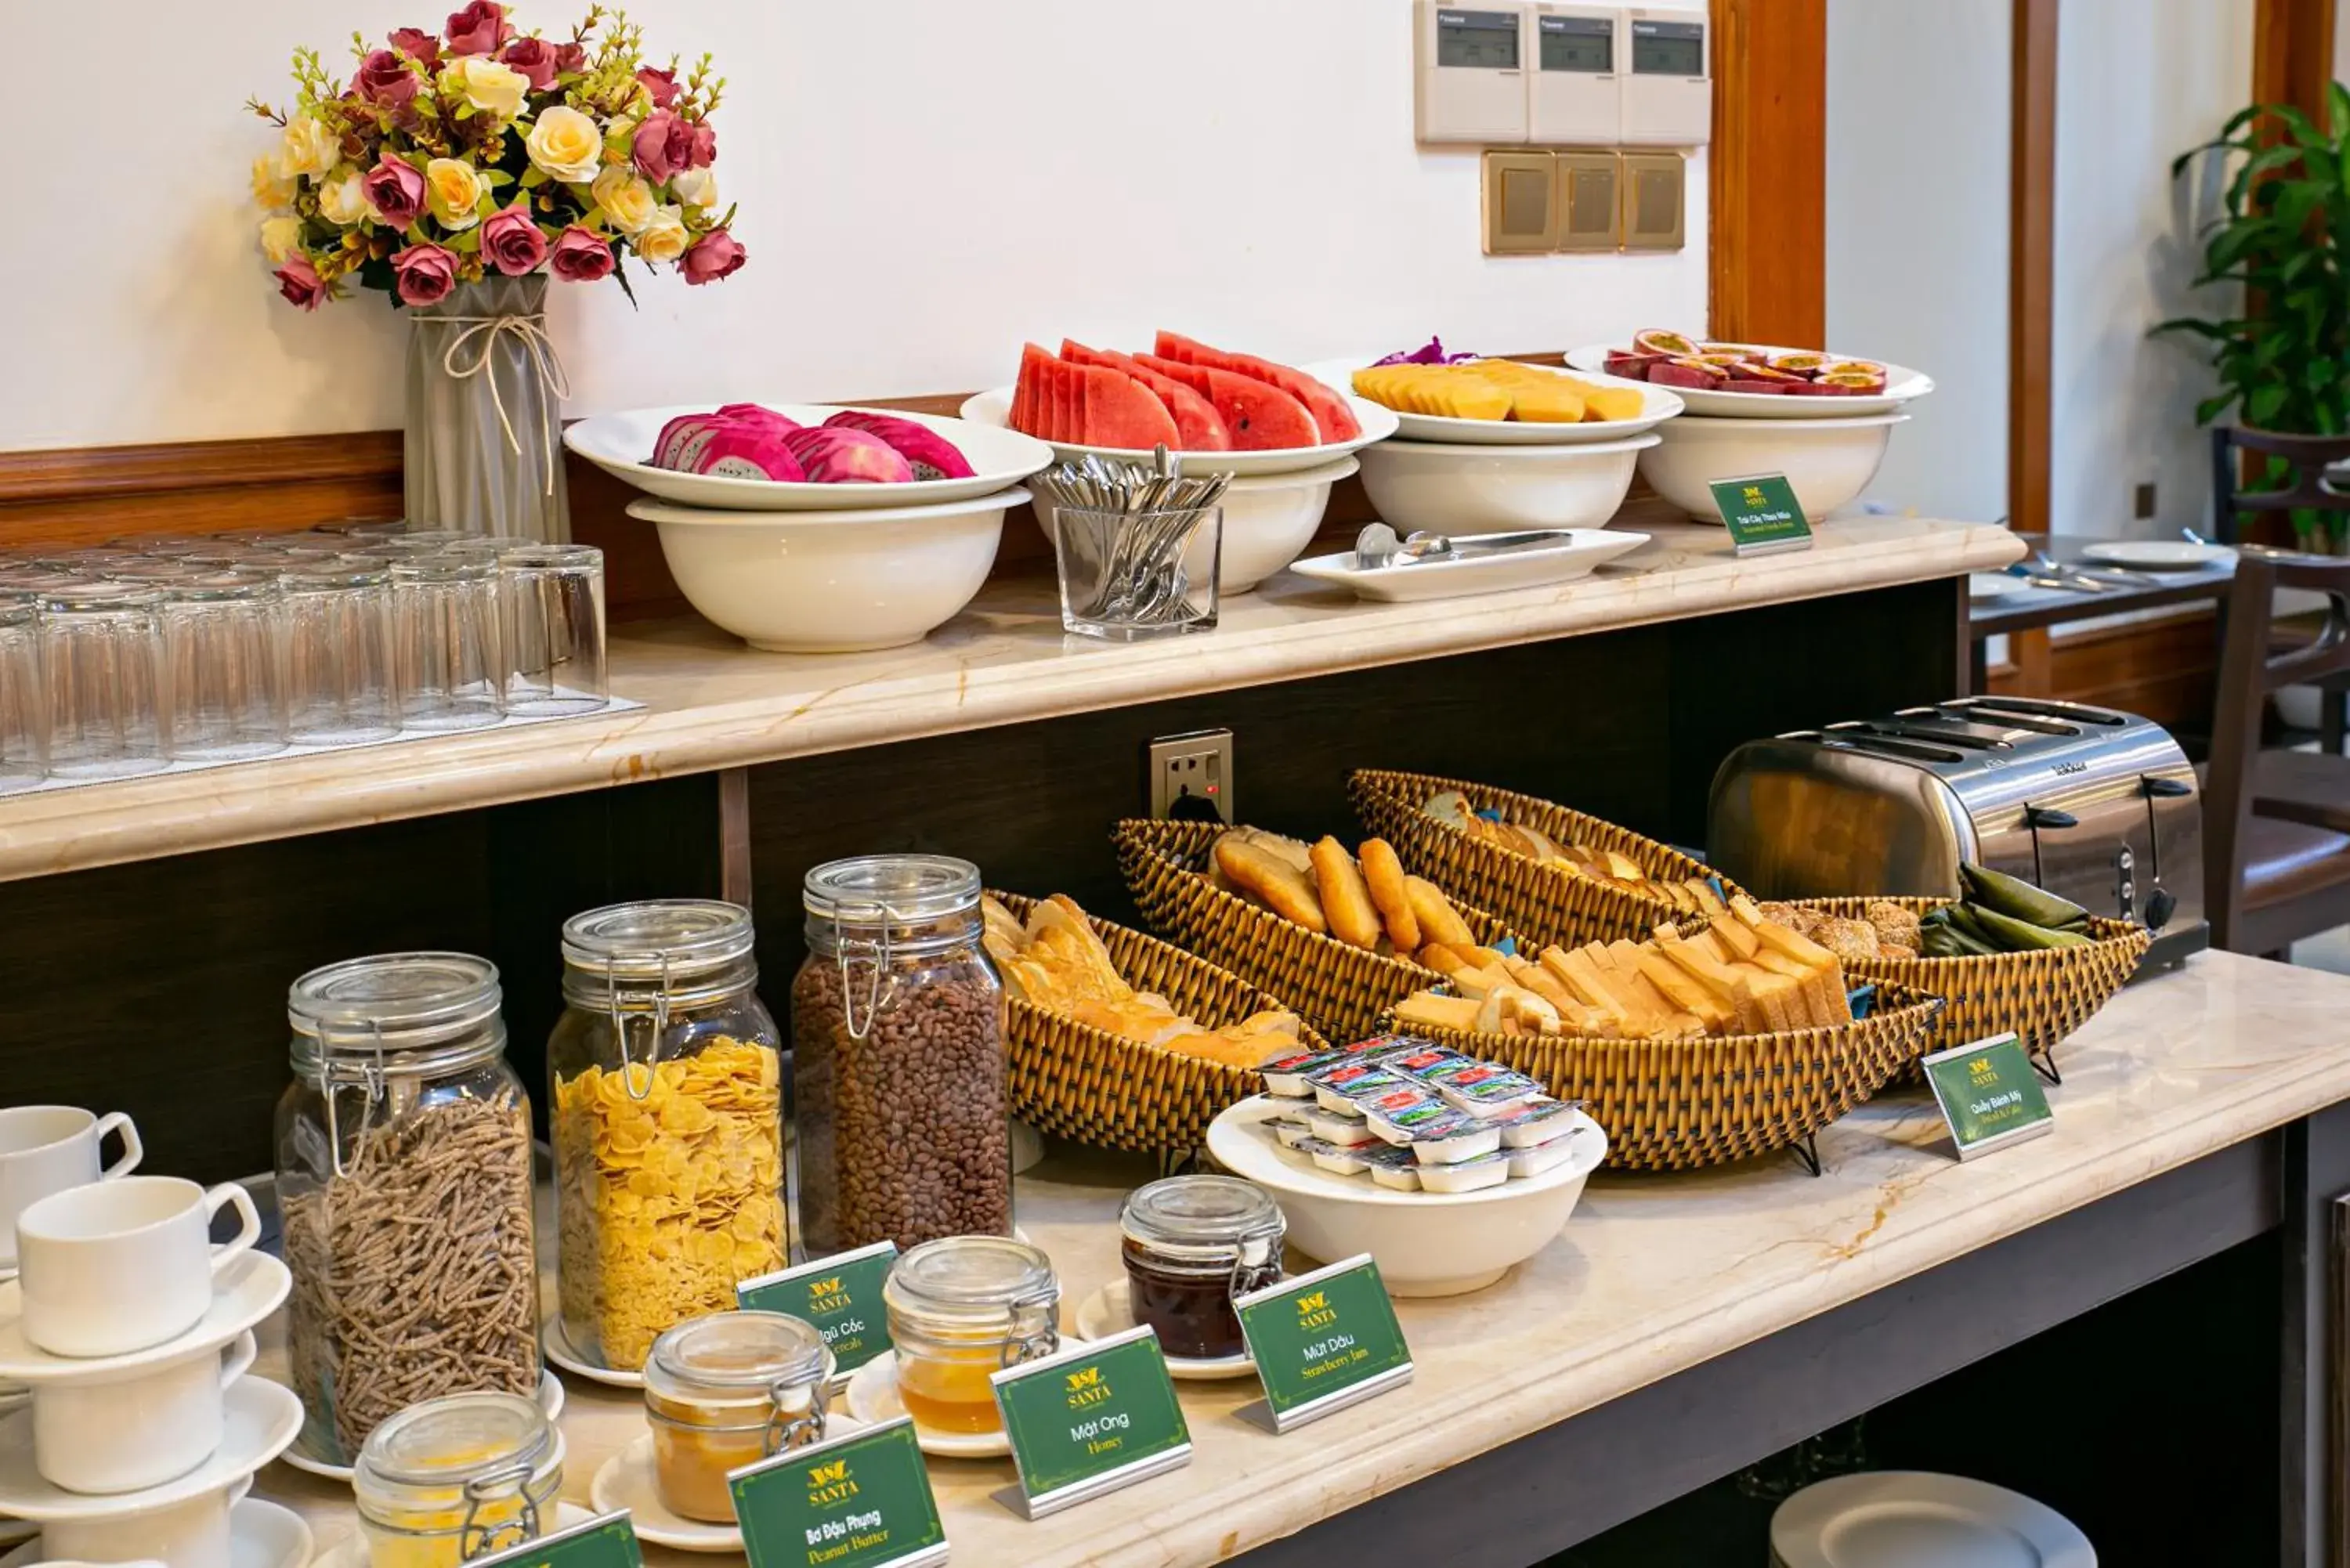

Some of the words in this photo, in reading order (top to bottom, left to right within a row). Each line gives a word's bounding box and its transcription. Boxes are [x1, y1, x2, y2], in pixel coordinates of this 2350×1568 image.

[809, 1293, 852, 1314] SANTA
[841, 1317, 866, 1335] Cốc
[1300, 1309, 1338, 1331] SANTA
[1302, 1356, 1350, 1379] Strawberry
[1349, 1348, 1369, 1365] Jam
[1303, 1342, 1329, 1361] Mứt
[1068, 1384, 1112, 1409] SANTA
[1070, 1421, 1100, 1443] Mật
[1100, 1413, 1130, 1431] Ong
[1087, 1436, 1123, 1455] Honey
[808, 1479, 860, 1508] SANTA
[805, 1526, 822, 1546] Bơ
[821, 1519, 848, 1540] Đậu
[845, 1508, 882, 1531] Phụng
[808, 1543, 849, 1565] Peanut
[851, 1530, 889, 1551] Butter
